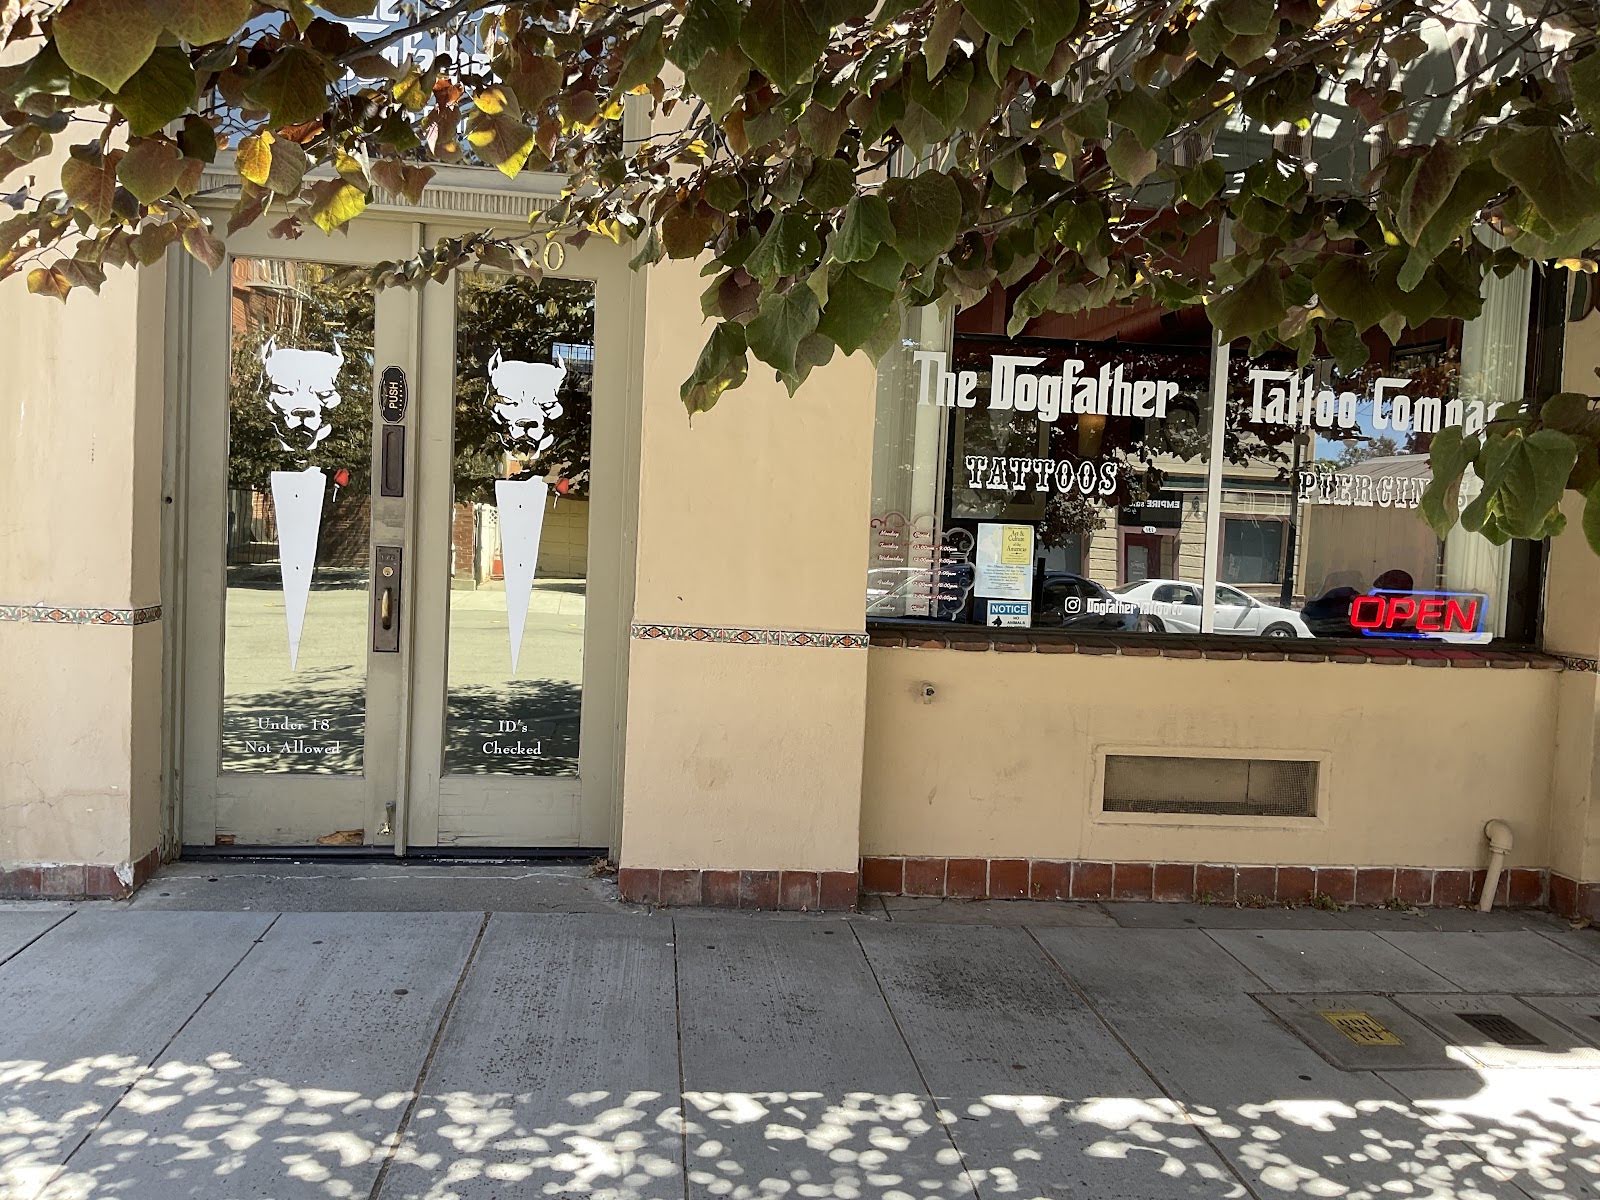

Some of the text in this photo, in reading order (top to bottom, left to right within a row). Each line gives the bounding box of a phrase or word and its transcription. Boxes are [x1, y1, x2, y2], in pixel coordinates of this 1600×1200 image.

[389, 382, 398, 409] PUSH
[913, 350, 978, 408] The
[987, 354, 1180, 422] Dogfather
[1248, 369, 1357, 429] Tattoo
[965, 455, 1118, 495] TATTOOS
[991, 604, 1027, 614] NOTICE
[1086, 597, 1139, 616] Dogfather
[1350, 596, 1478, 632] OPEN
[257, 717, 330, 731] Under 18
[497, 719, 528, 734] ID's
[245, 740, 342, 755] Not Allowed
[482, 741, 542, 755] Checked
